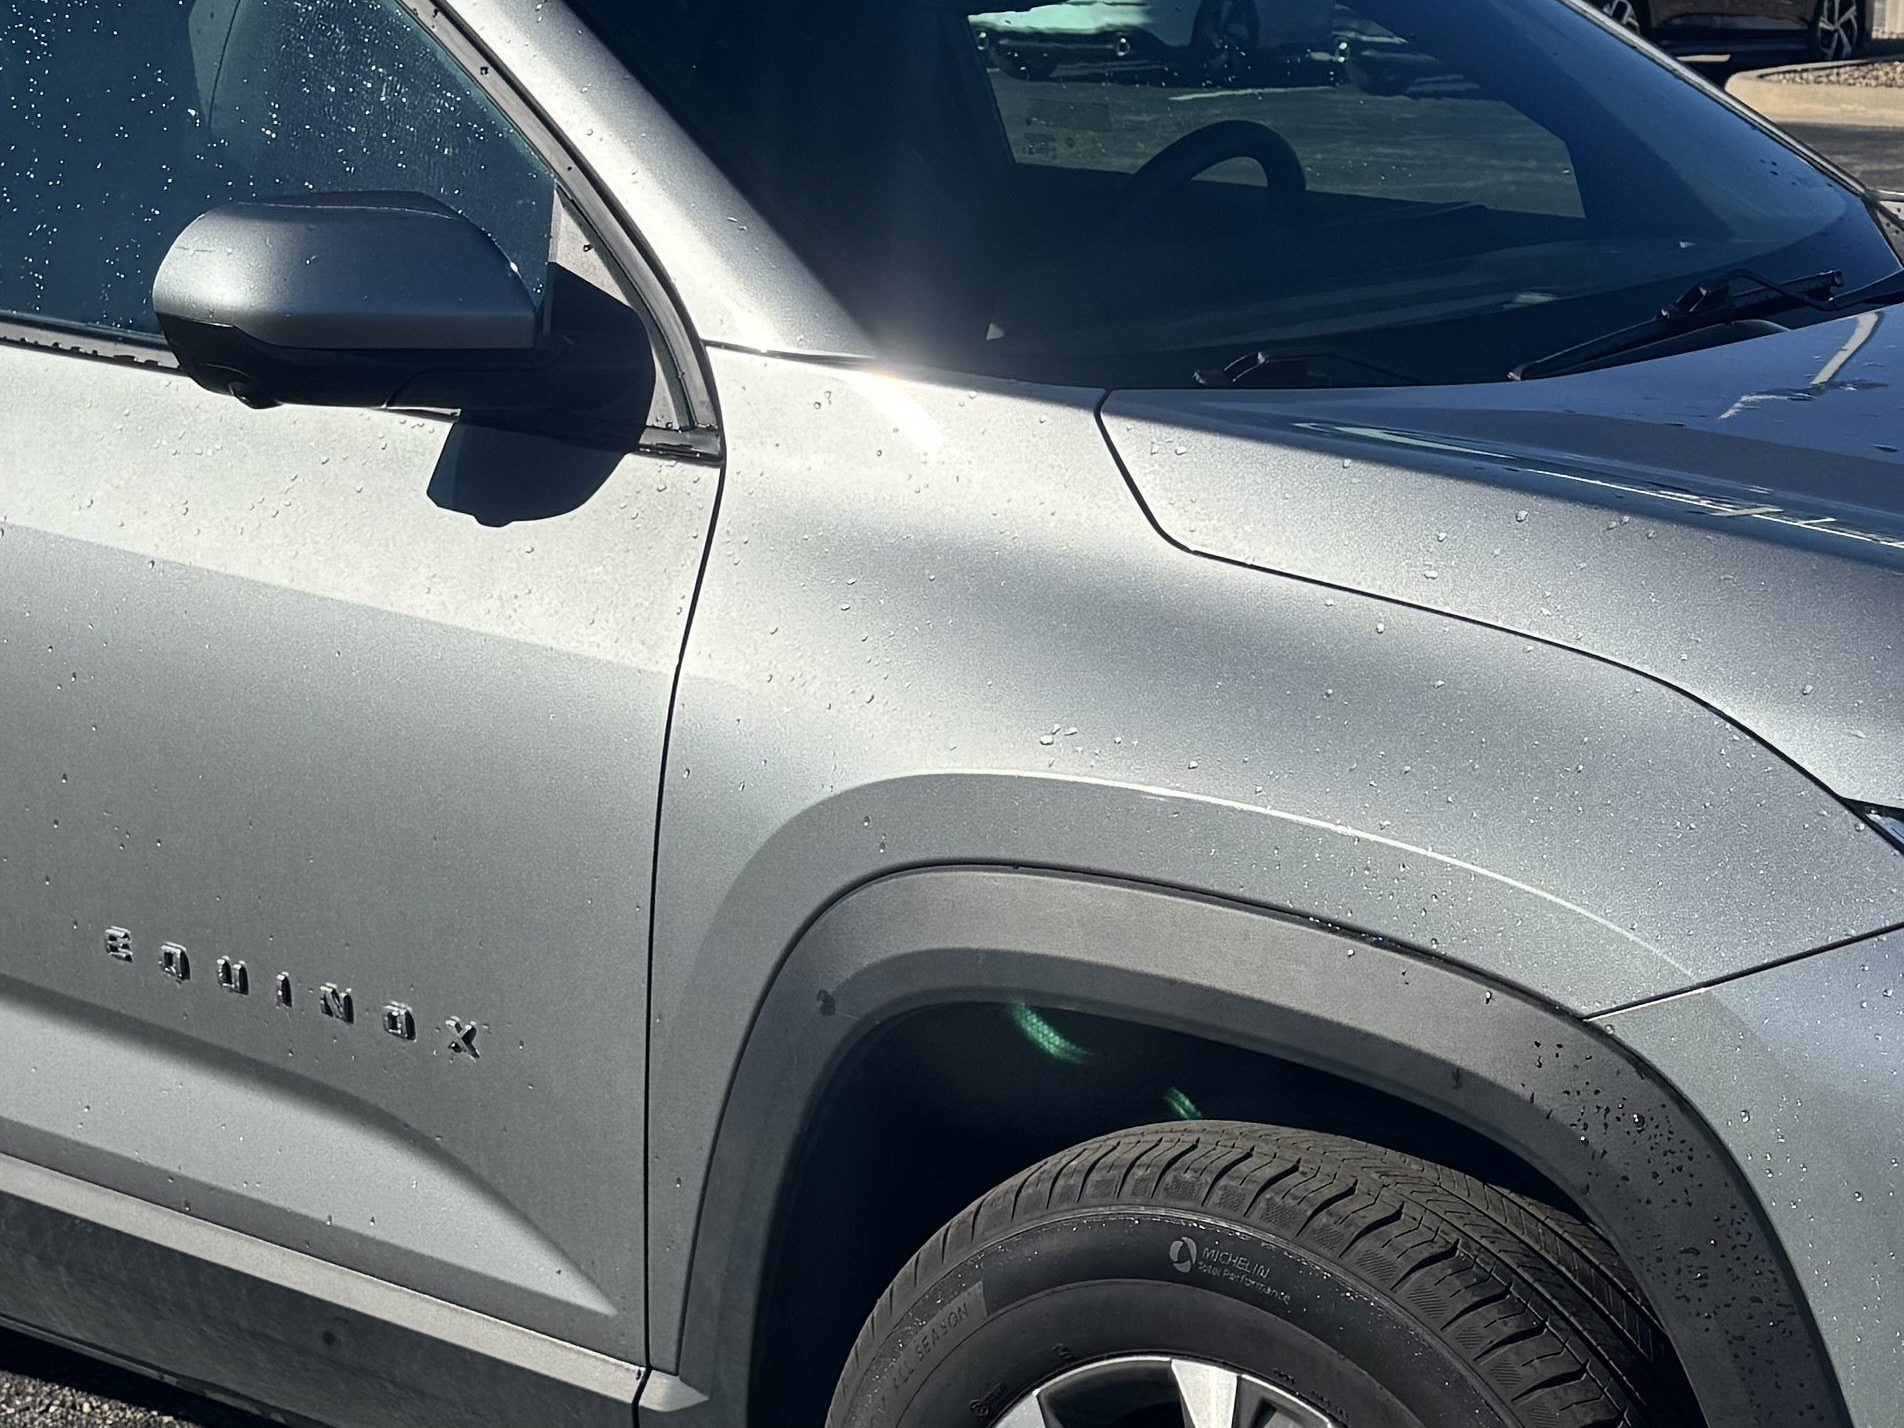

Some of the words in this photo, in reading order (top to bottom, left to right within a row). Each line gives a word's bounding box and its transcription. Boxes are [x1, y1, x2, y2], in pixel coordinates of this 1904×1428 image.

[104, 925, 481, 1061] EQUINOX
[1201, 1246, 1271, 1279] MICHELIN
[914, 1301, 969, 1363] SEASON
